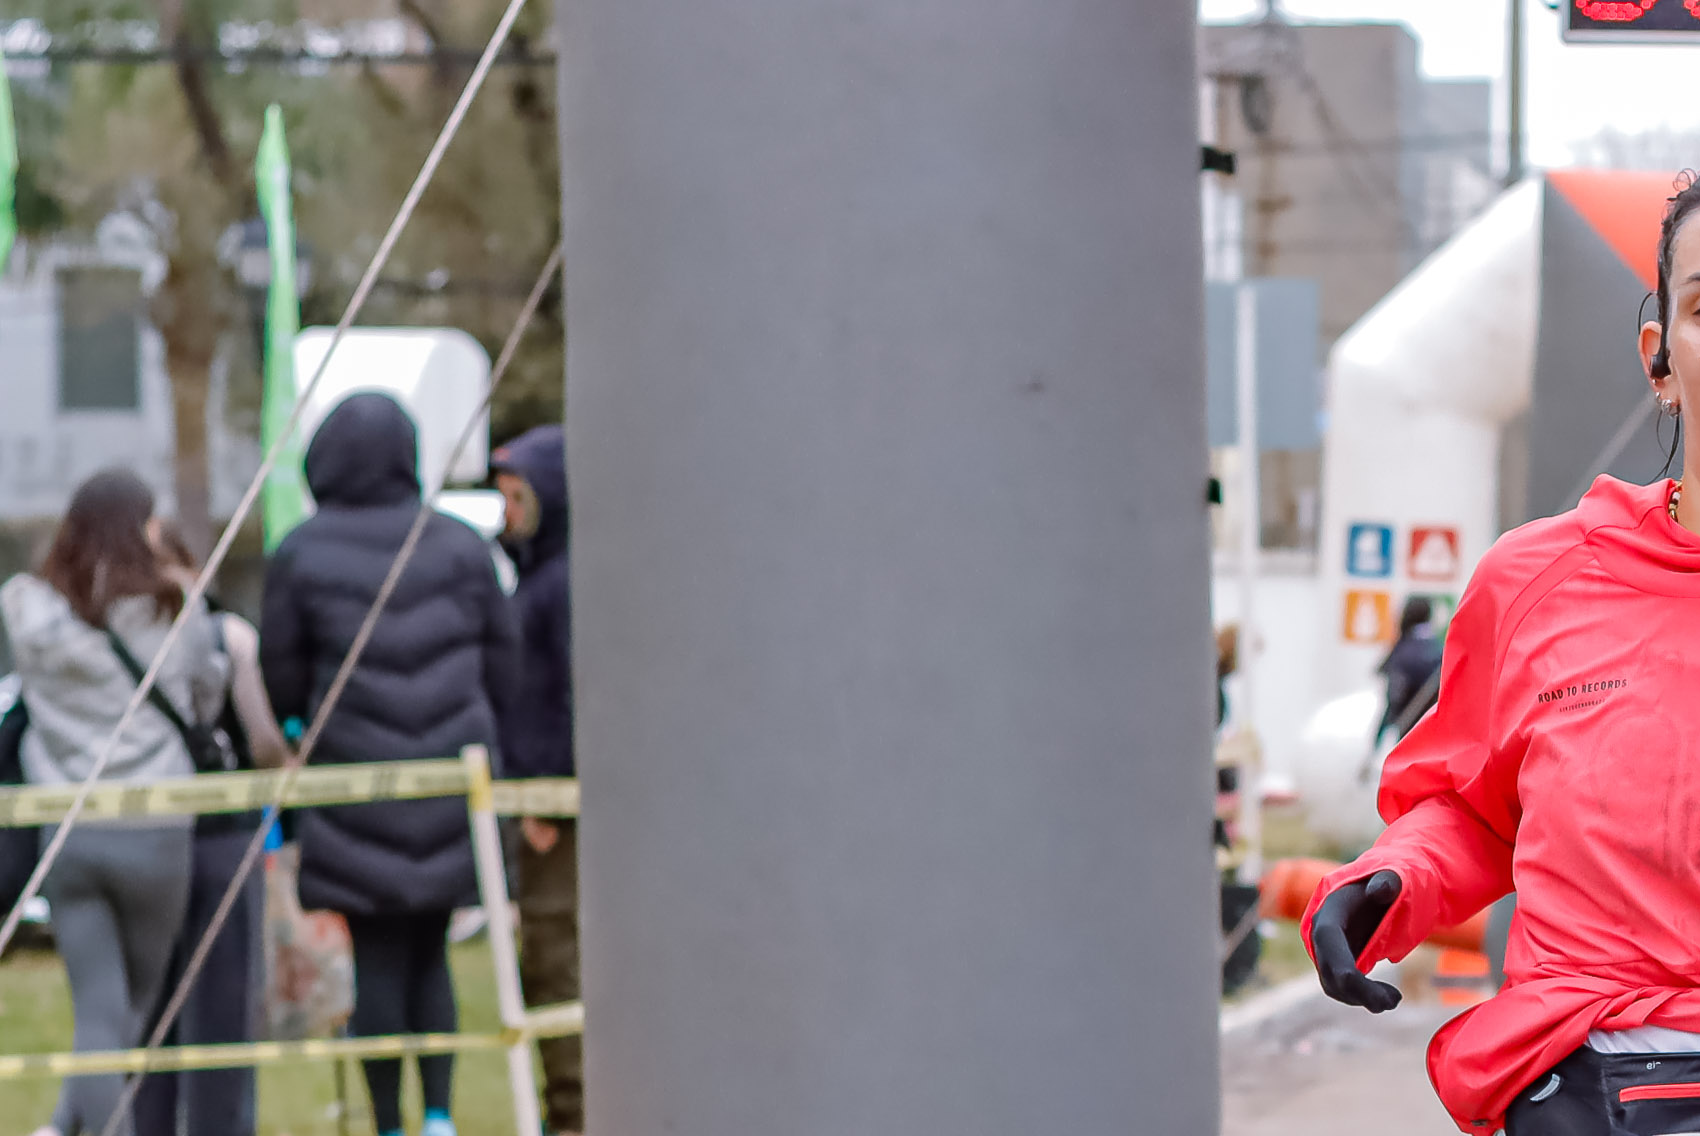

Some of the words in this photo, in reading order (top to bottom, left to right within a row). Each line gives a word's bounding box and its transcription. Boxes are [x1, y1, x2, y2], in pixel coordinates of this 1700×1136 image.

[1538, 688, 1564, 703] ROAD
[1567, 686, 1577, 696] TO
[1582, 679, 1627, 693] RECORDS
